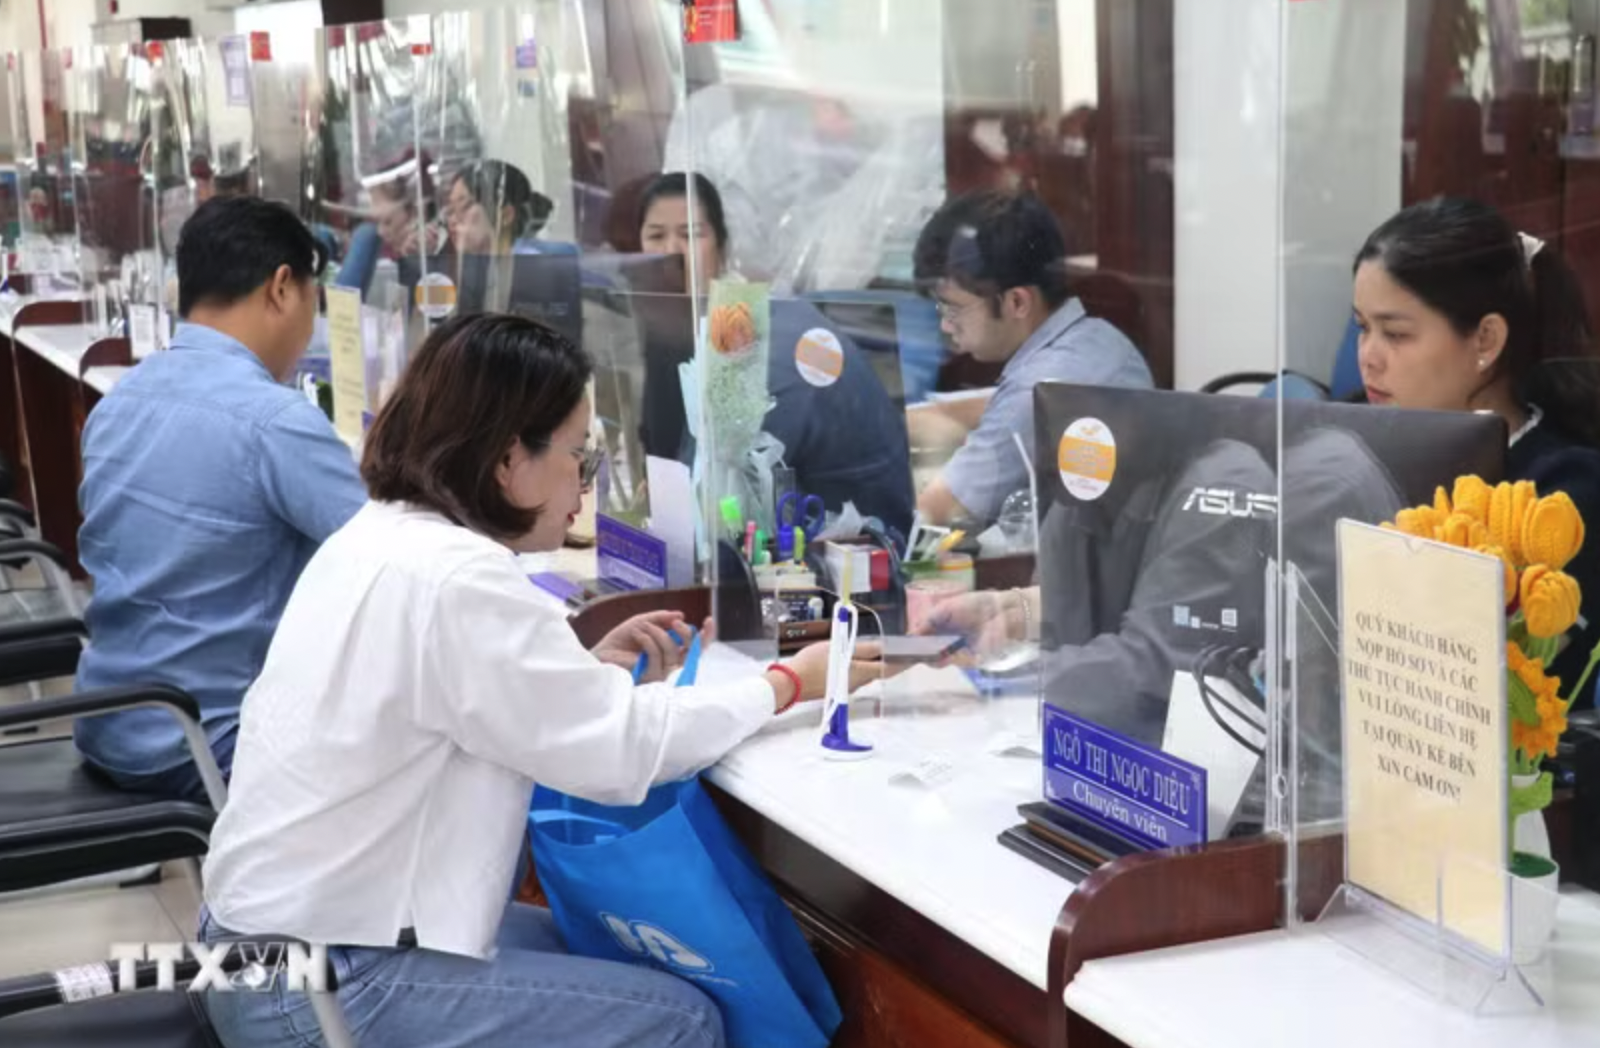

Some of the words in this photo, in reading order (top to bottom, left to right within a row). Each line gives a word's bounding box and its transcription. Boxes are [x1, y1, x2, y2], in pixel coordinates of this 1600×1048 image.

[1182, 487, 1278, 519] ASUS
[1355, 611, 1384, 633] QUÝ
[1387, 620, 1435, 650] KHÁCH
[1437, 637, 1478, 665] HÀNG
[1375, 668, 1403, 693] TỤC
[1405, 678, 1443, 708] HÀNH
[1445, 695, 1491, 726] CHÍNH
[1428, 659, 1447, 682] VÀ
[1449, 667, 1478, 692] CÁC
[1358, 688, 1381, 711] VUI
[1384, 698, 1422, 726] LÒNG
[1424, 713, 1456, 738] LIÊN
[1053, 727, 1081, 765] NGÔ
[1084, 741, 1108, 785] THỊ
[1111, 753, 1150, 799] NGỌC
[1154, 770, 1191, 817] DIỆU
[1361, 719, 1384, 742] TẠI
[1449, 751, 1476, 777] BÊN
[1073, 780, 1130, 824] Chuyên
[1133, 812, 1167, 842] viên
